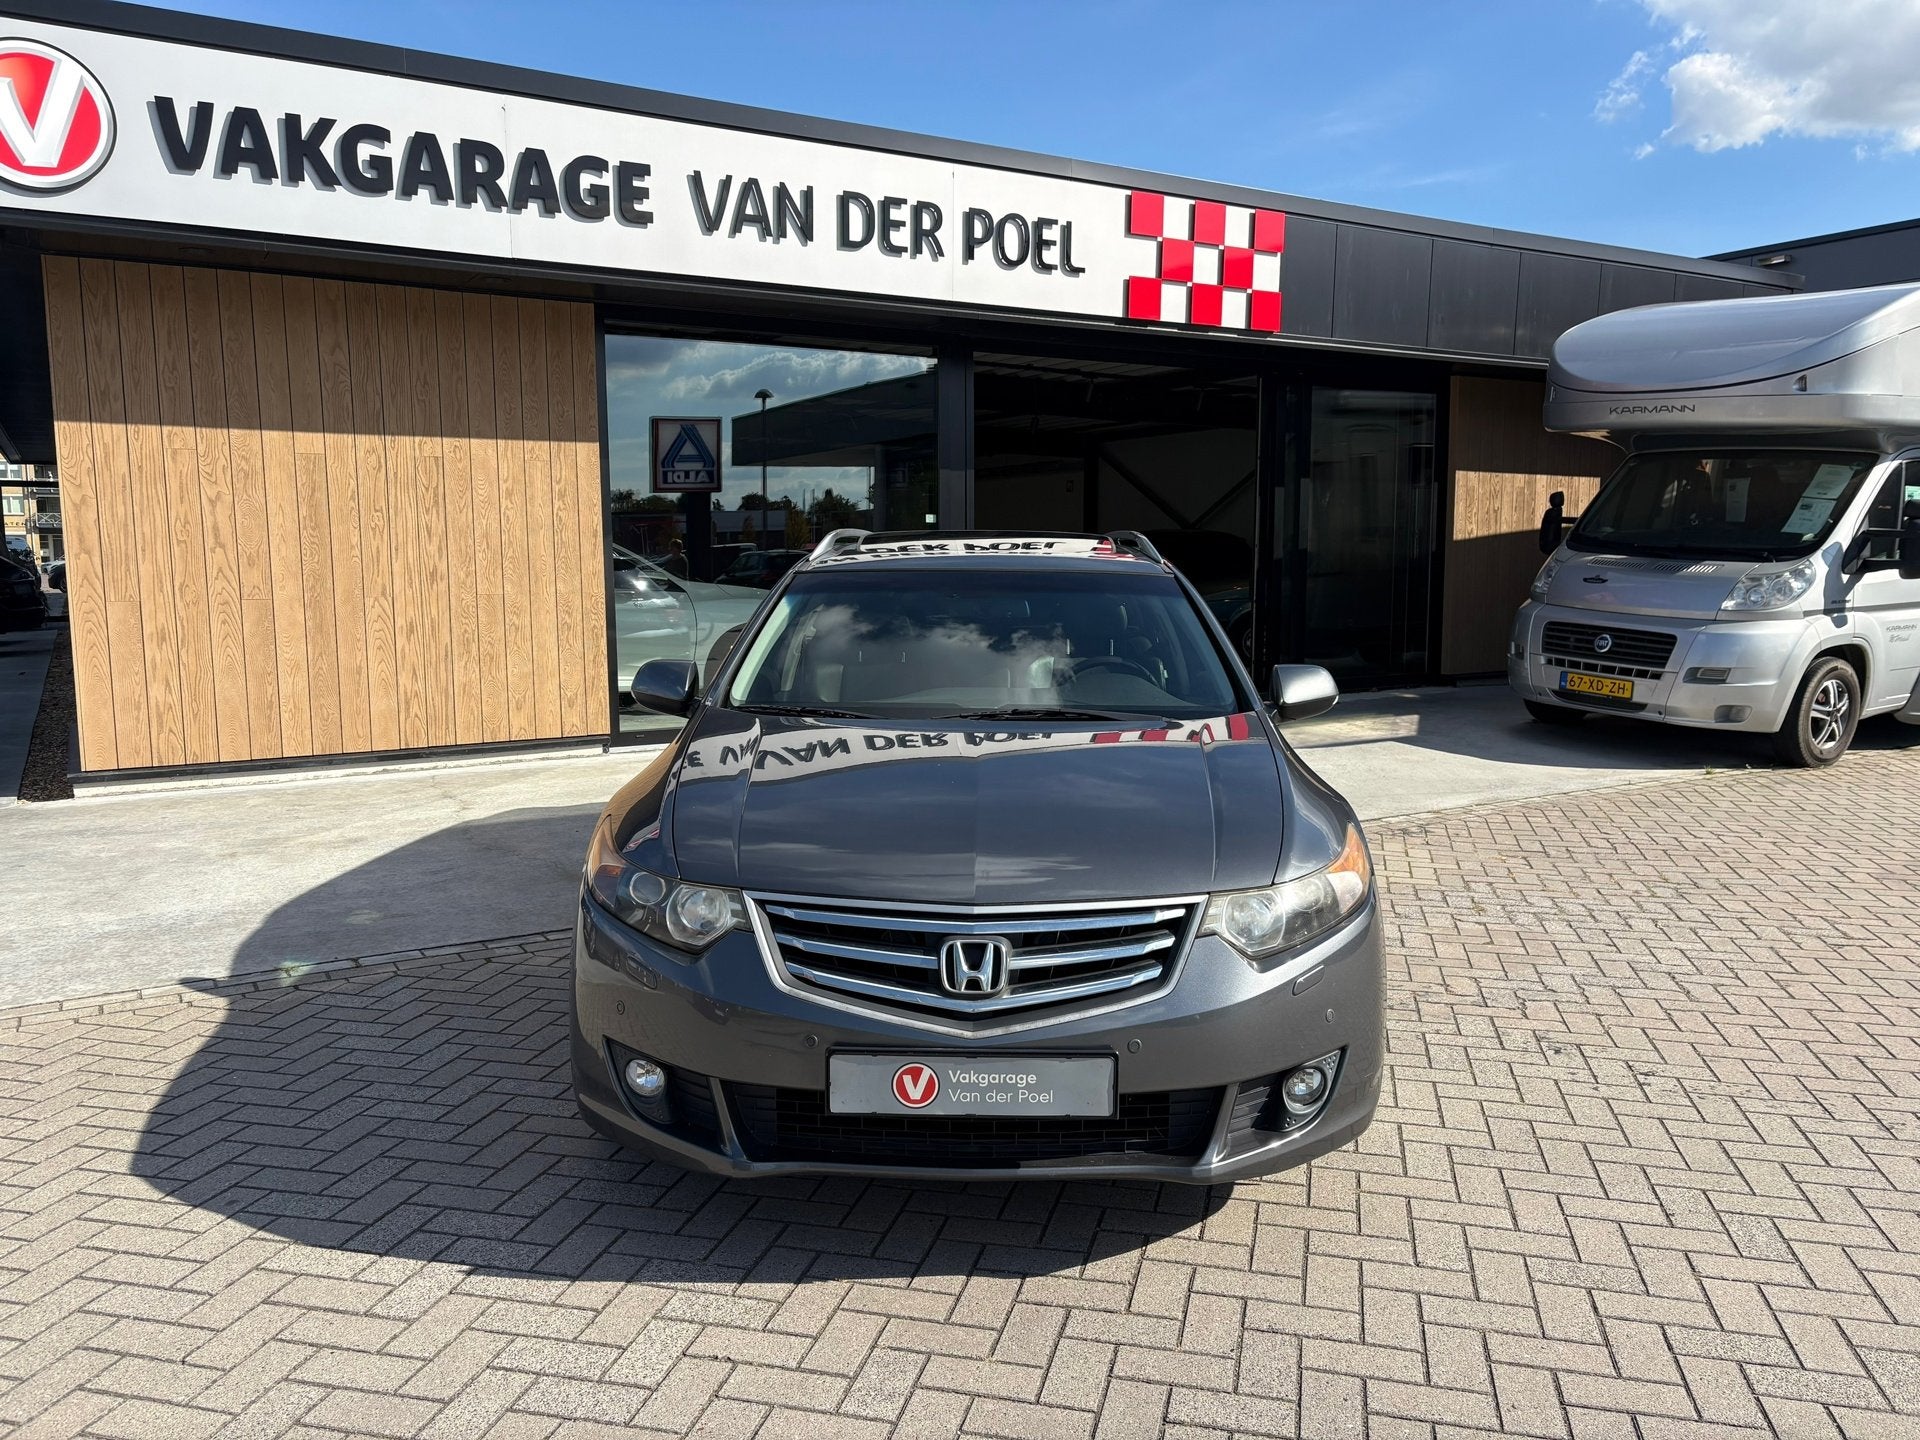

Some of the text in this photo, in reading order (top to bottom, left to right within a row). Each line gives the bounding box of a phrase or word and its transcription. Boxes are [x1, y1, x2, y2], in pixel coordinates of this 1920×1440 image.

[149, 96, 1086, 275] VAKGARAGE VAN DER POEL
[1609, 404, 1696, 415] KARMANN
[1568, 675, 1627, 696] 67-XD-ZH
[948, 1070, 1037, 1087] Vakgarage
[948, 1088, 1053, 1103] Van der Poel
